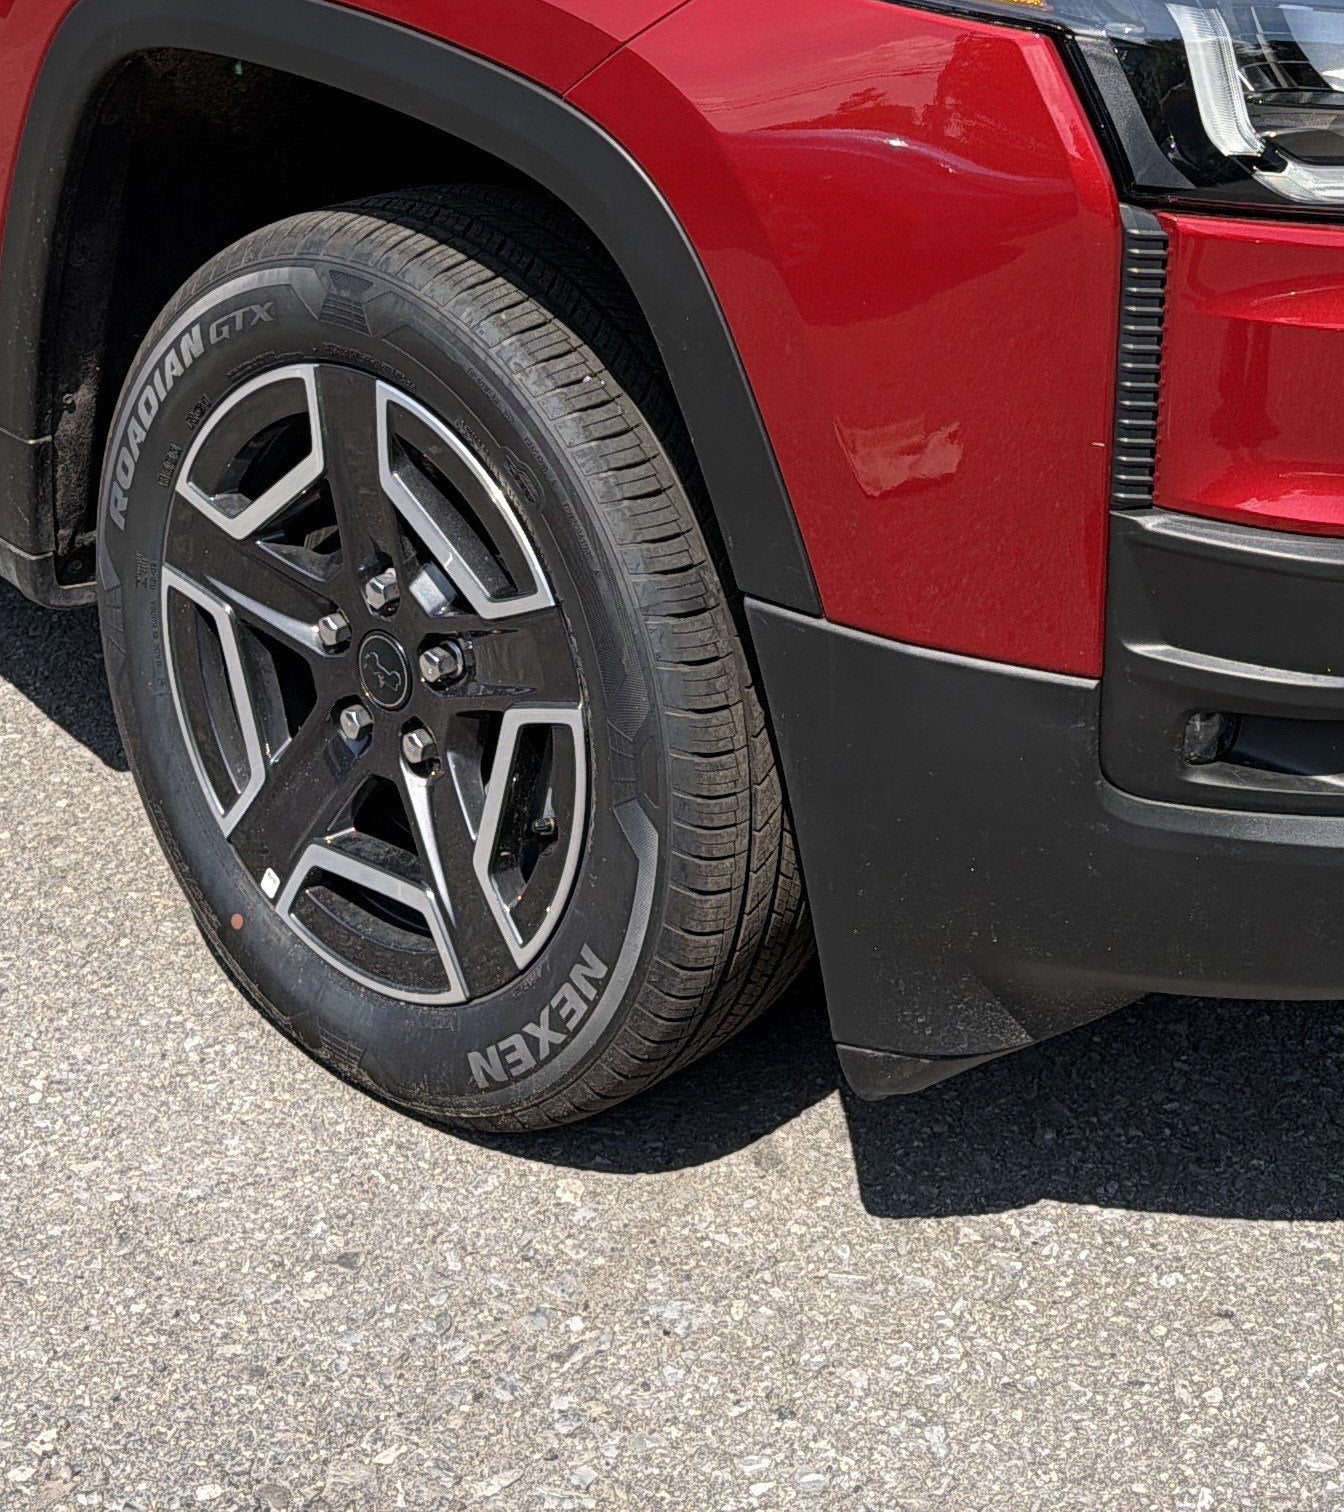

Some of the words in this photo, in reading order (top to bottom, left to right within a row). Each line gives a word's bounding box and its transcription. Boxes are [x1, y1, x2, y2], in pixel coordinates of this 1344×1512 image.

[108, 322, 205, 532] ROADIAN
[209, 300, 275, 346] GTX
[467, 942, 609, 1089] NEXEN
